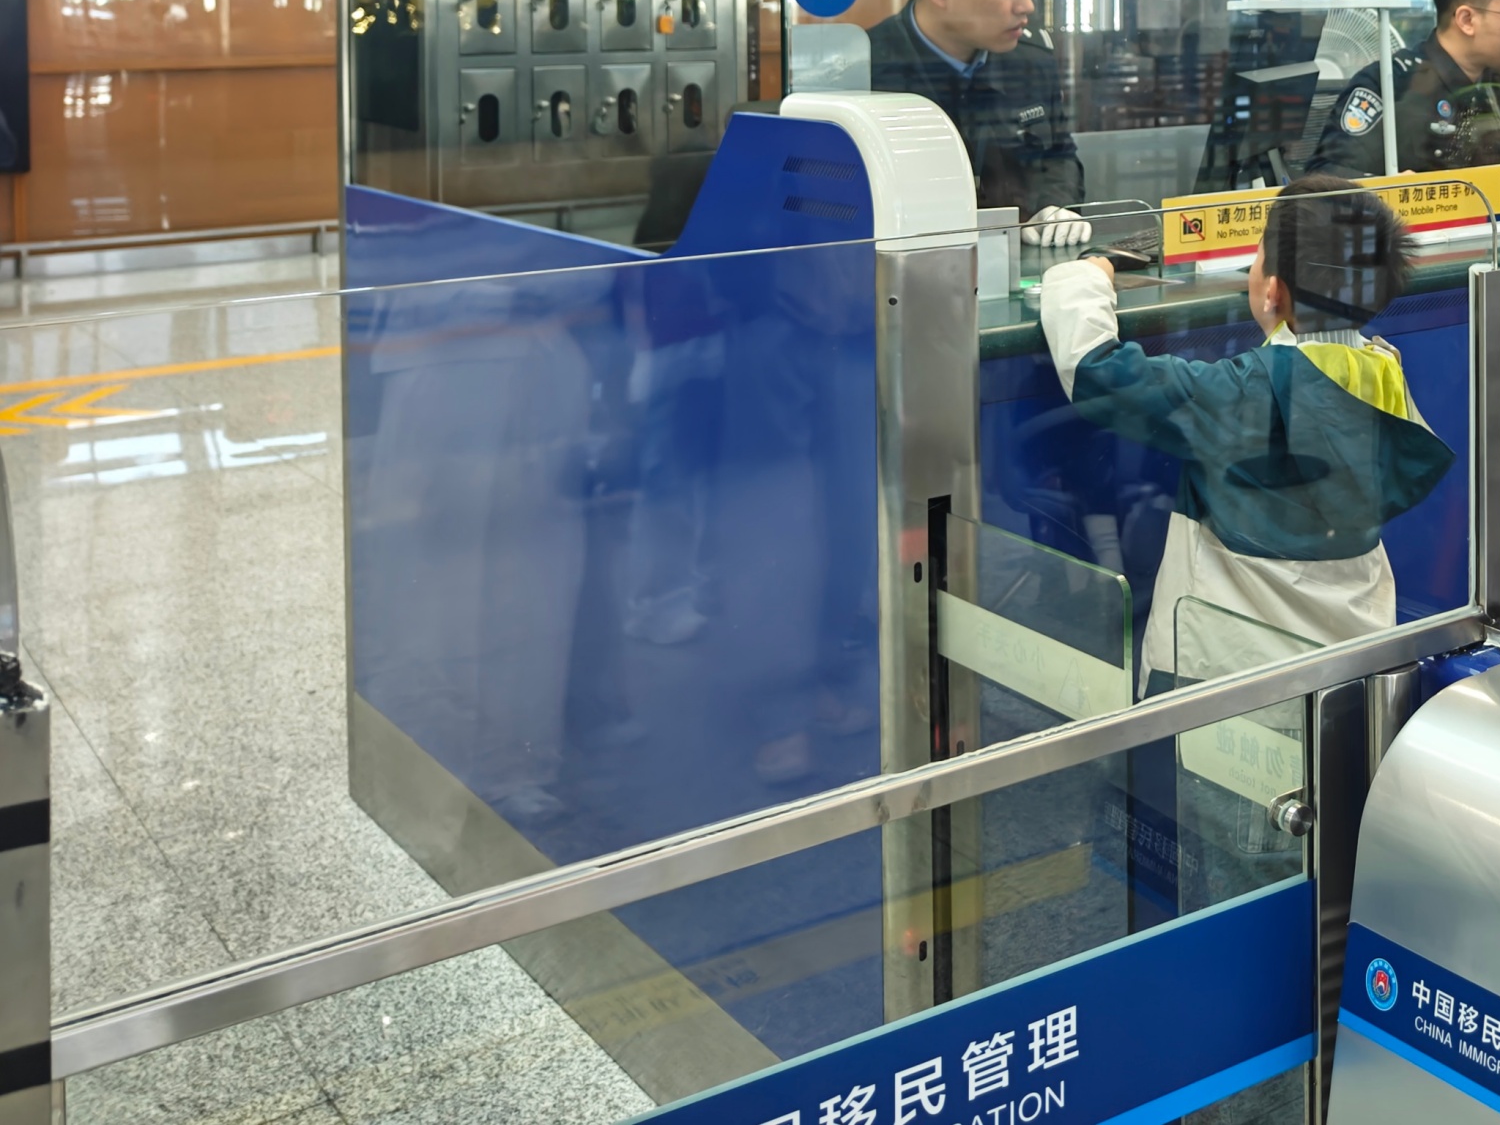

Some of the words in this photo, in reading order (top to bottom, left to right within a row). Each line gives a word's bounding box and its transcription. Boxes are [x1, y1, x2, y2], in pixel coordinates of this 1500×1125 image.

[1410, 204, 1434, 216] Mobile
[1436, 202, 1459, 212] Phone
[1217, 230, 1228, 239] No
[1228, 227, 1250, 238] Photo
[1413, 1015, 1453, 1048] CHINA
[758, 1005, 1080, 1125] 移民管理
[952, 1080, 1065, 1125] ATION
